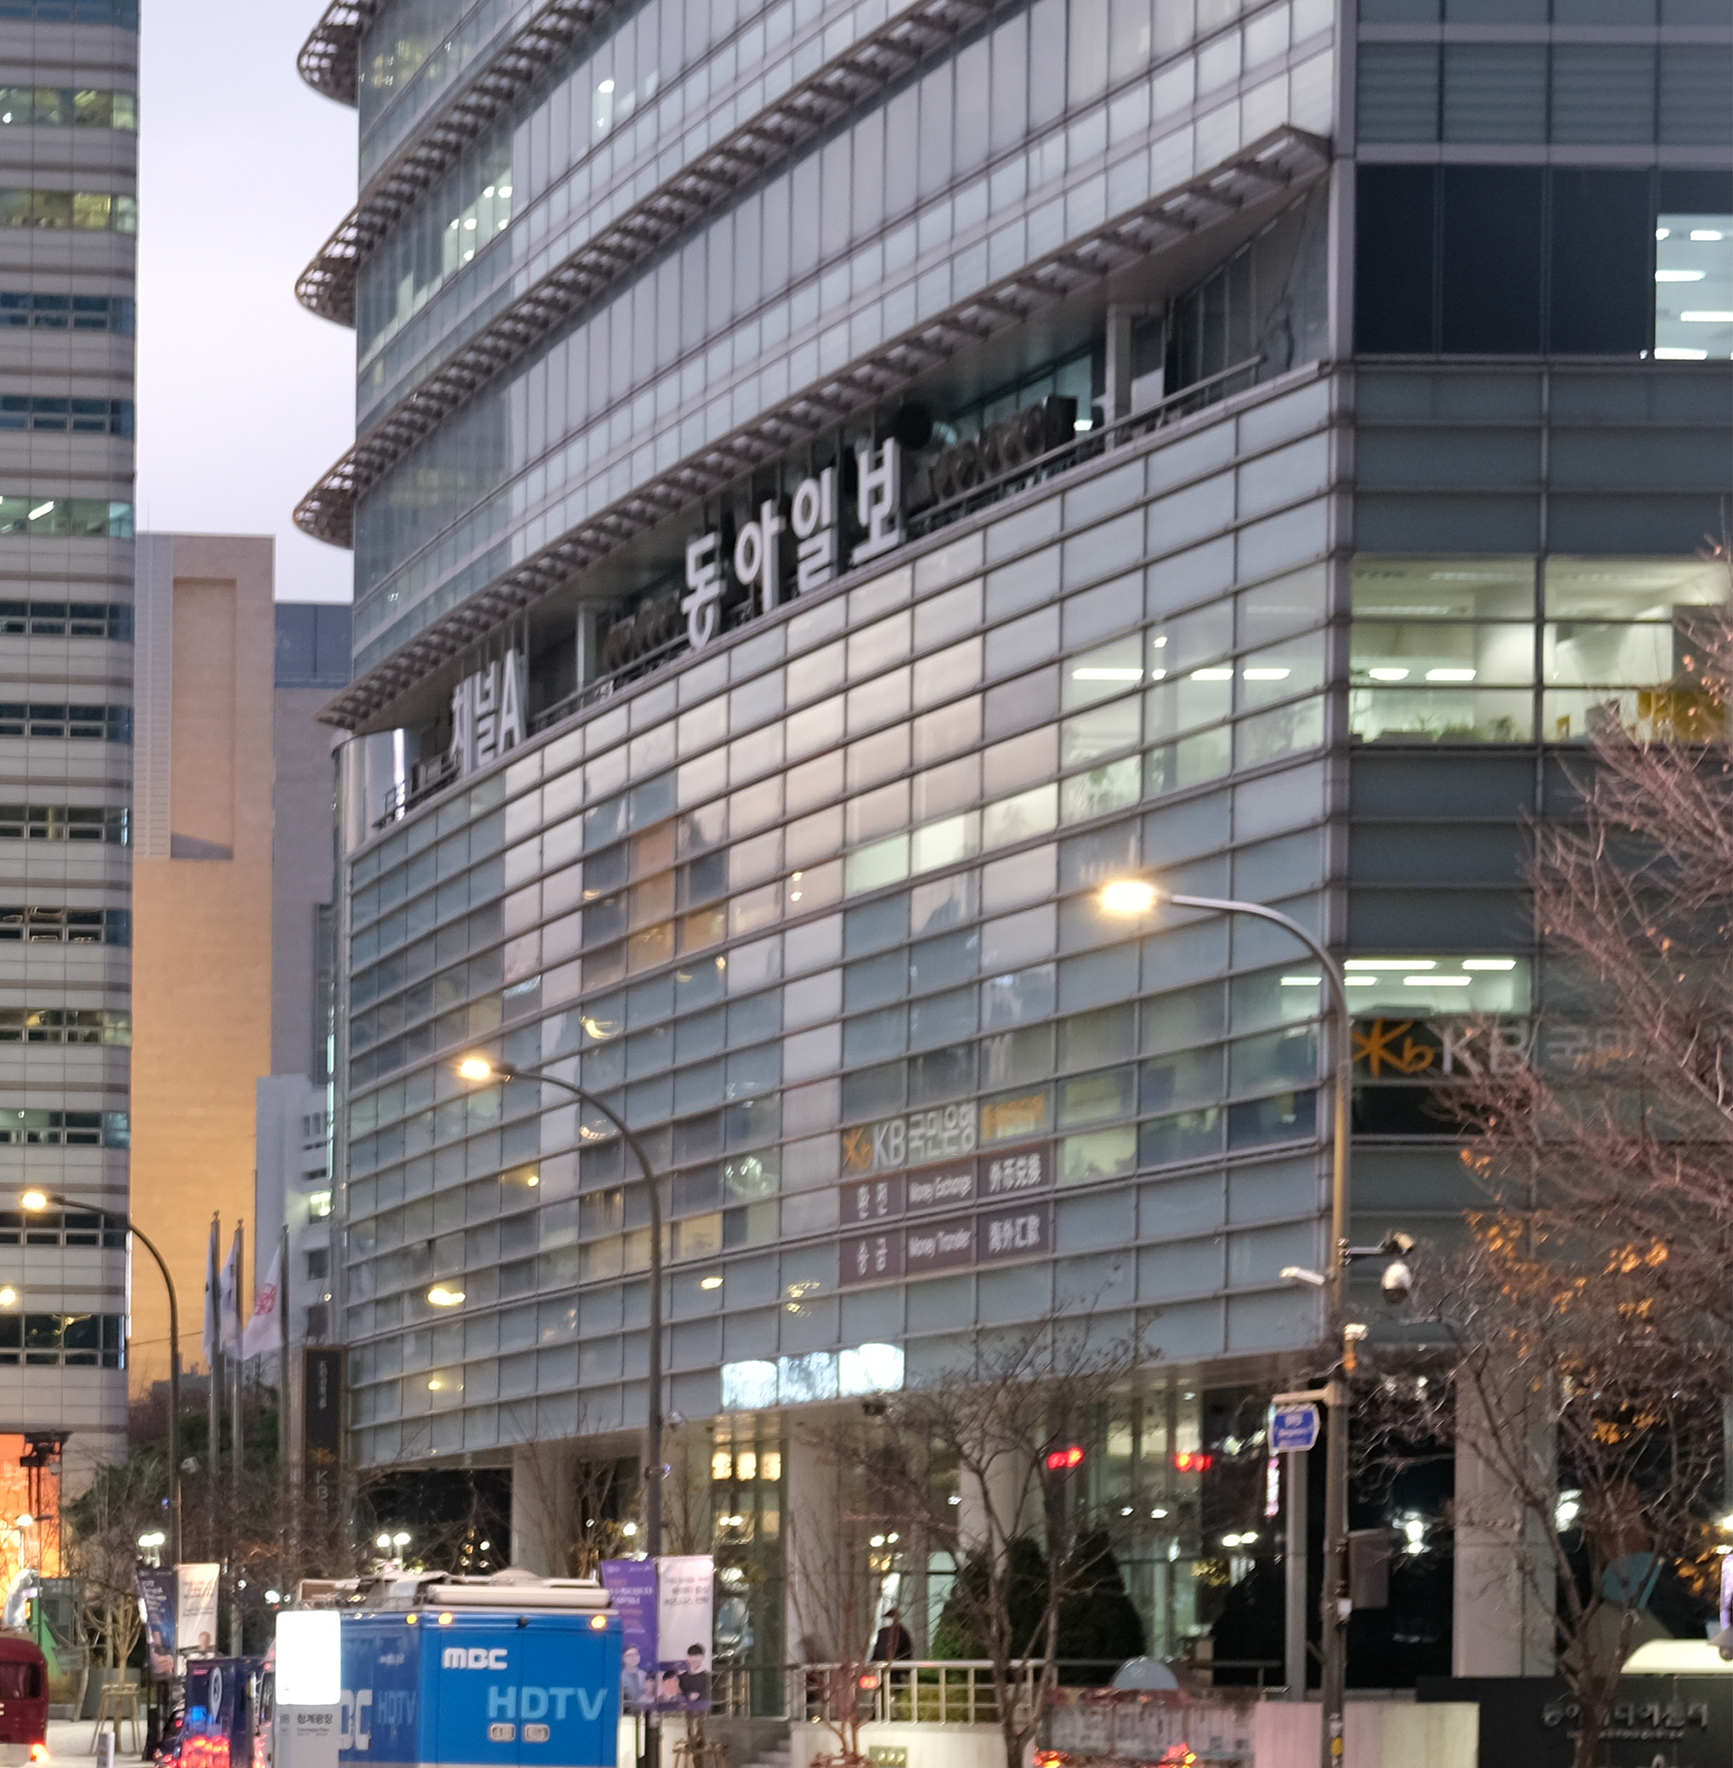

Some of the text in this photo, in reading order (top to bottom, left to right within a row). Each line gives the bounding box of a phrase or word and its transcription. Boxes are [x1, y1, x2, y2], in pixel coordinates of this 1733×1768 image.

[682, 437, 906, 651] 동아일보
[451, 650, 528, 780] 채널A
[443, 1647, 508, 1671] MBC
[296, 1713, 333, 1725] 청계광장
[378, 1690, 417, 1725] HDTV
[488, 1685, 609, 1721] HDTV
